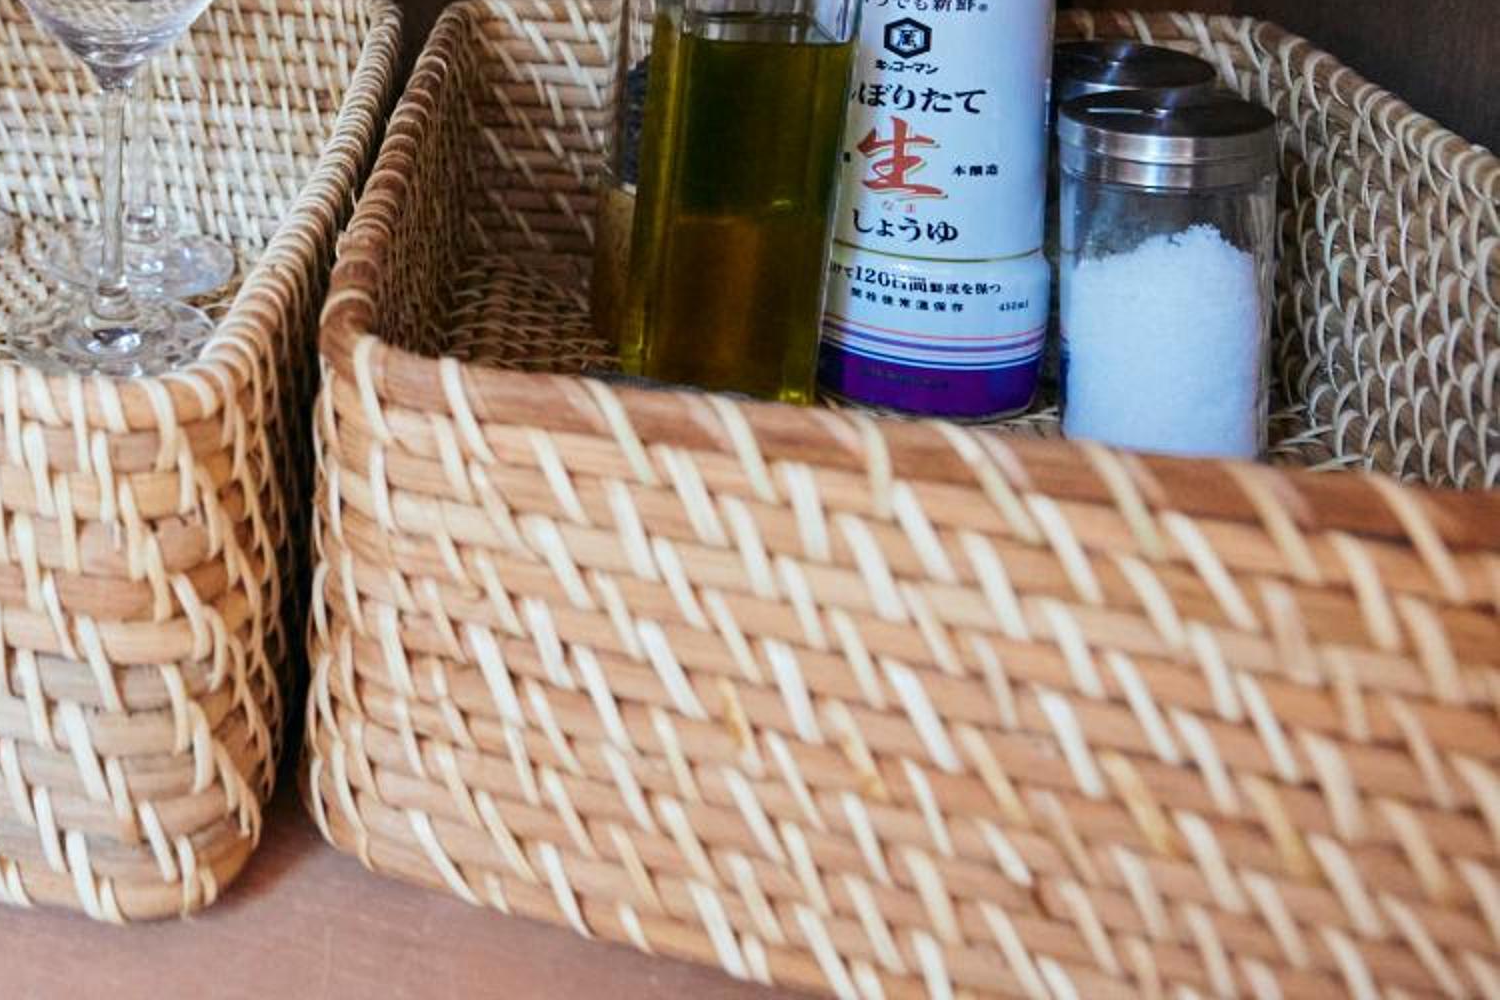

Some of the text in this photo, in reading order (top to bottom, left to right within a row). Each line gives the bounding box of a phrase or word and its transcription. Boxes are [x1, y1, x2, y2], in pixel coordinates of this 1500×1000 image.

[875, 59, 939, 75] キッコーマン
[853, 80, 987, 114] ぼりたて
[856, 115, 949, 199] 生
[852, 208, 959, 242] しょうゆ
